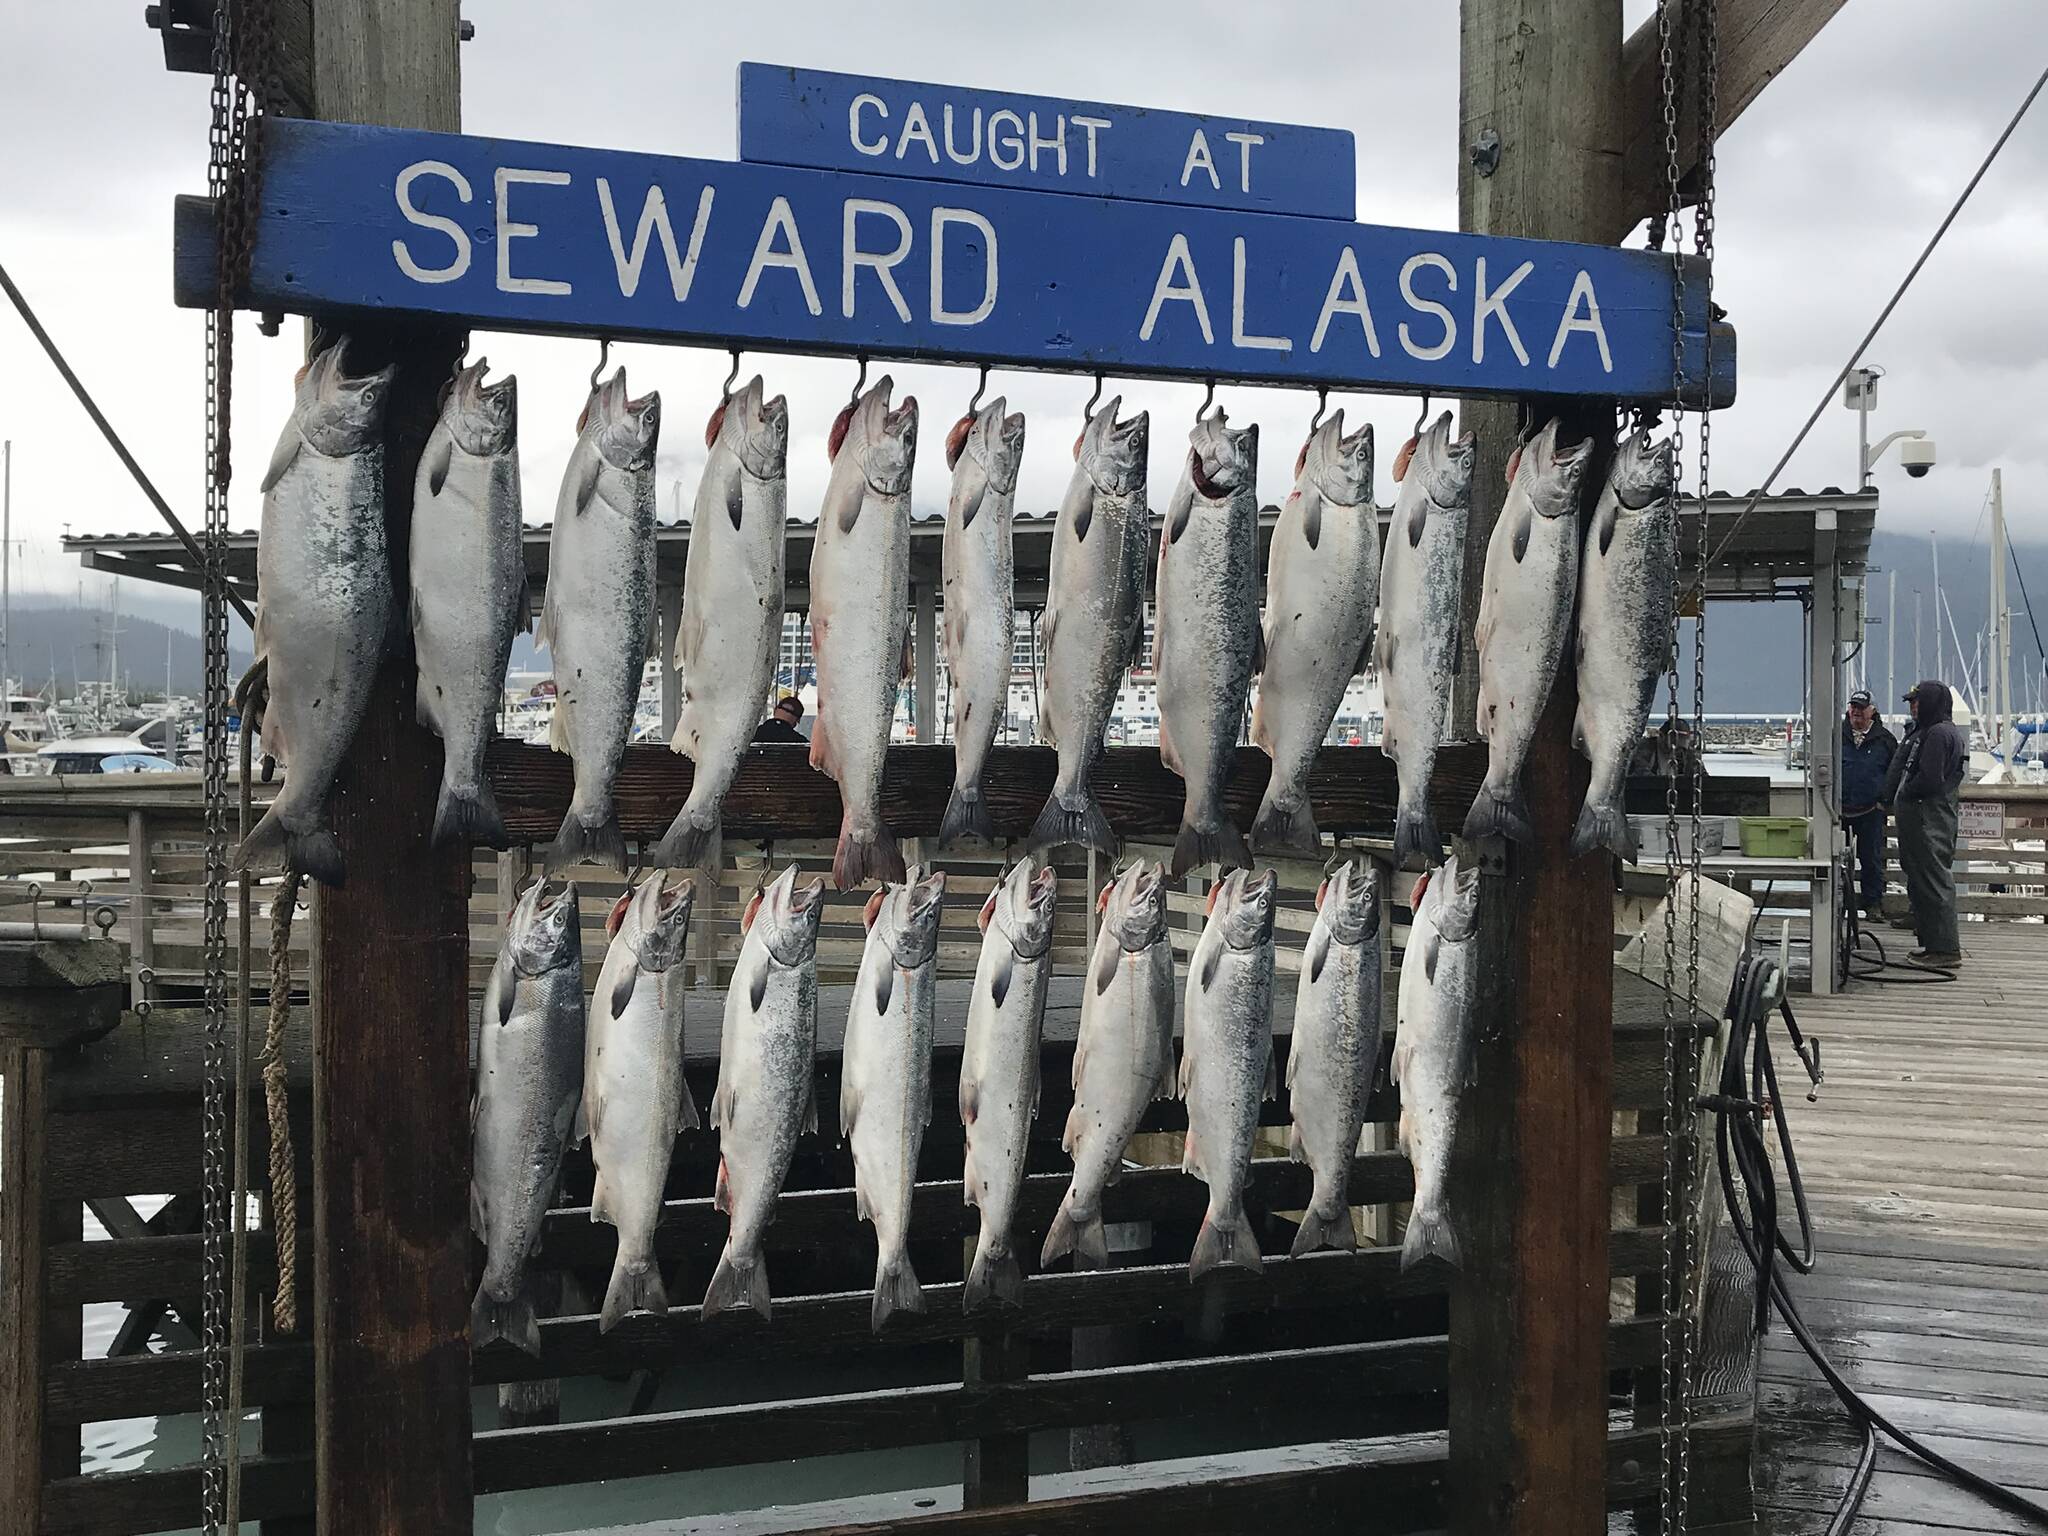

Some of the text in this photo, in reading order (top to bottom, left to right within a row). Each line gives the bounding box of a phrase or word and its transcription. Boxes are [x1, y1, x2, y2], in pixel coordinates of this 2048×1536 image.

[849, 93, 1265, 193] CAUGHT AT
[392, 160, 1613, 373] SEWARD ALASKA
